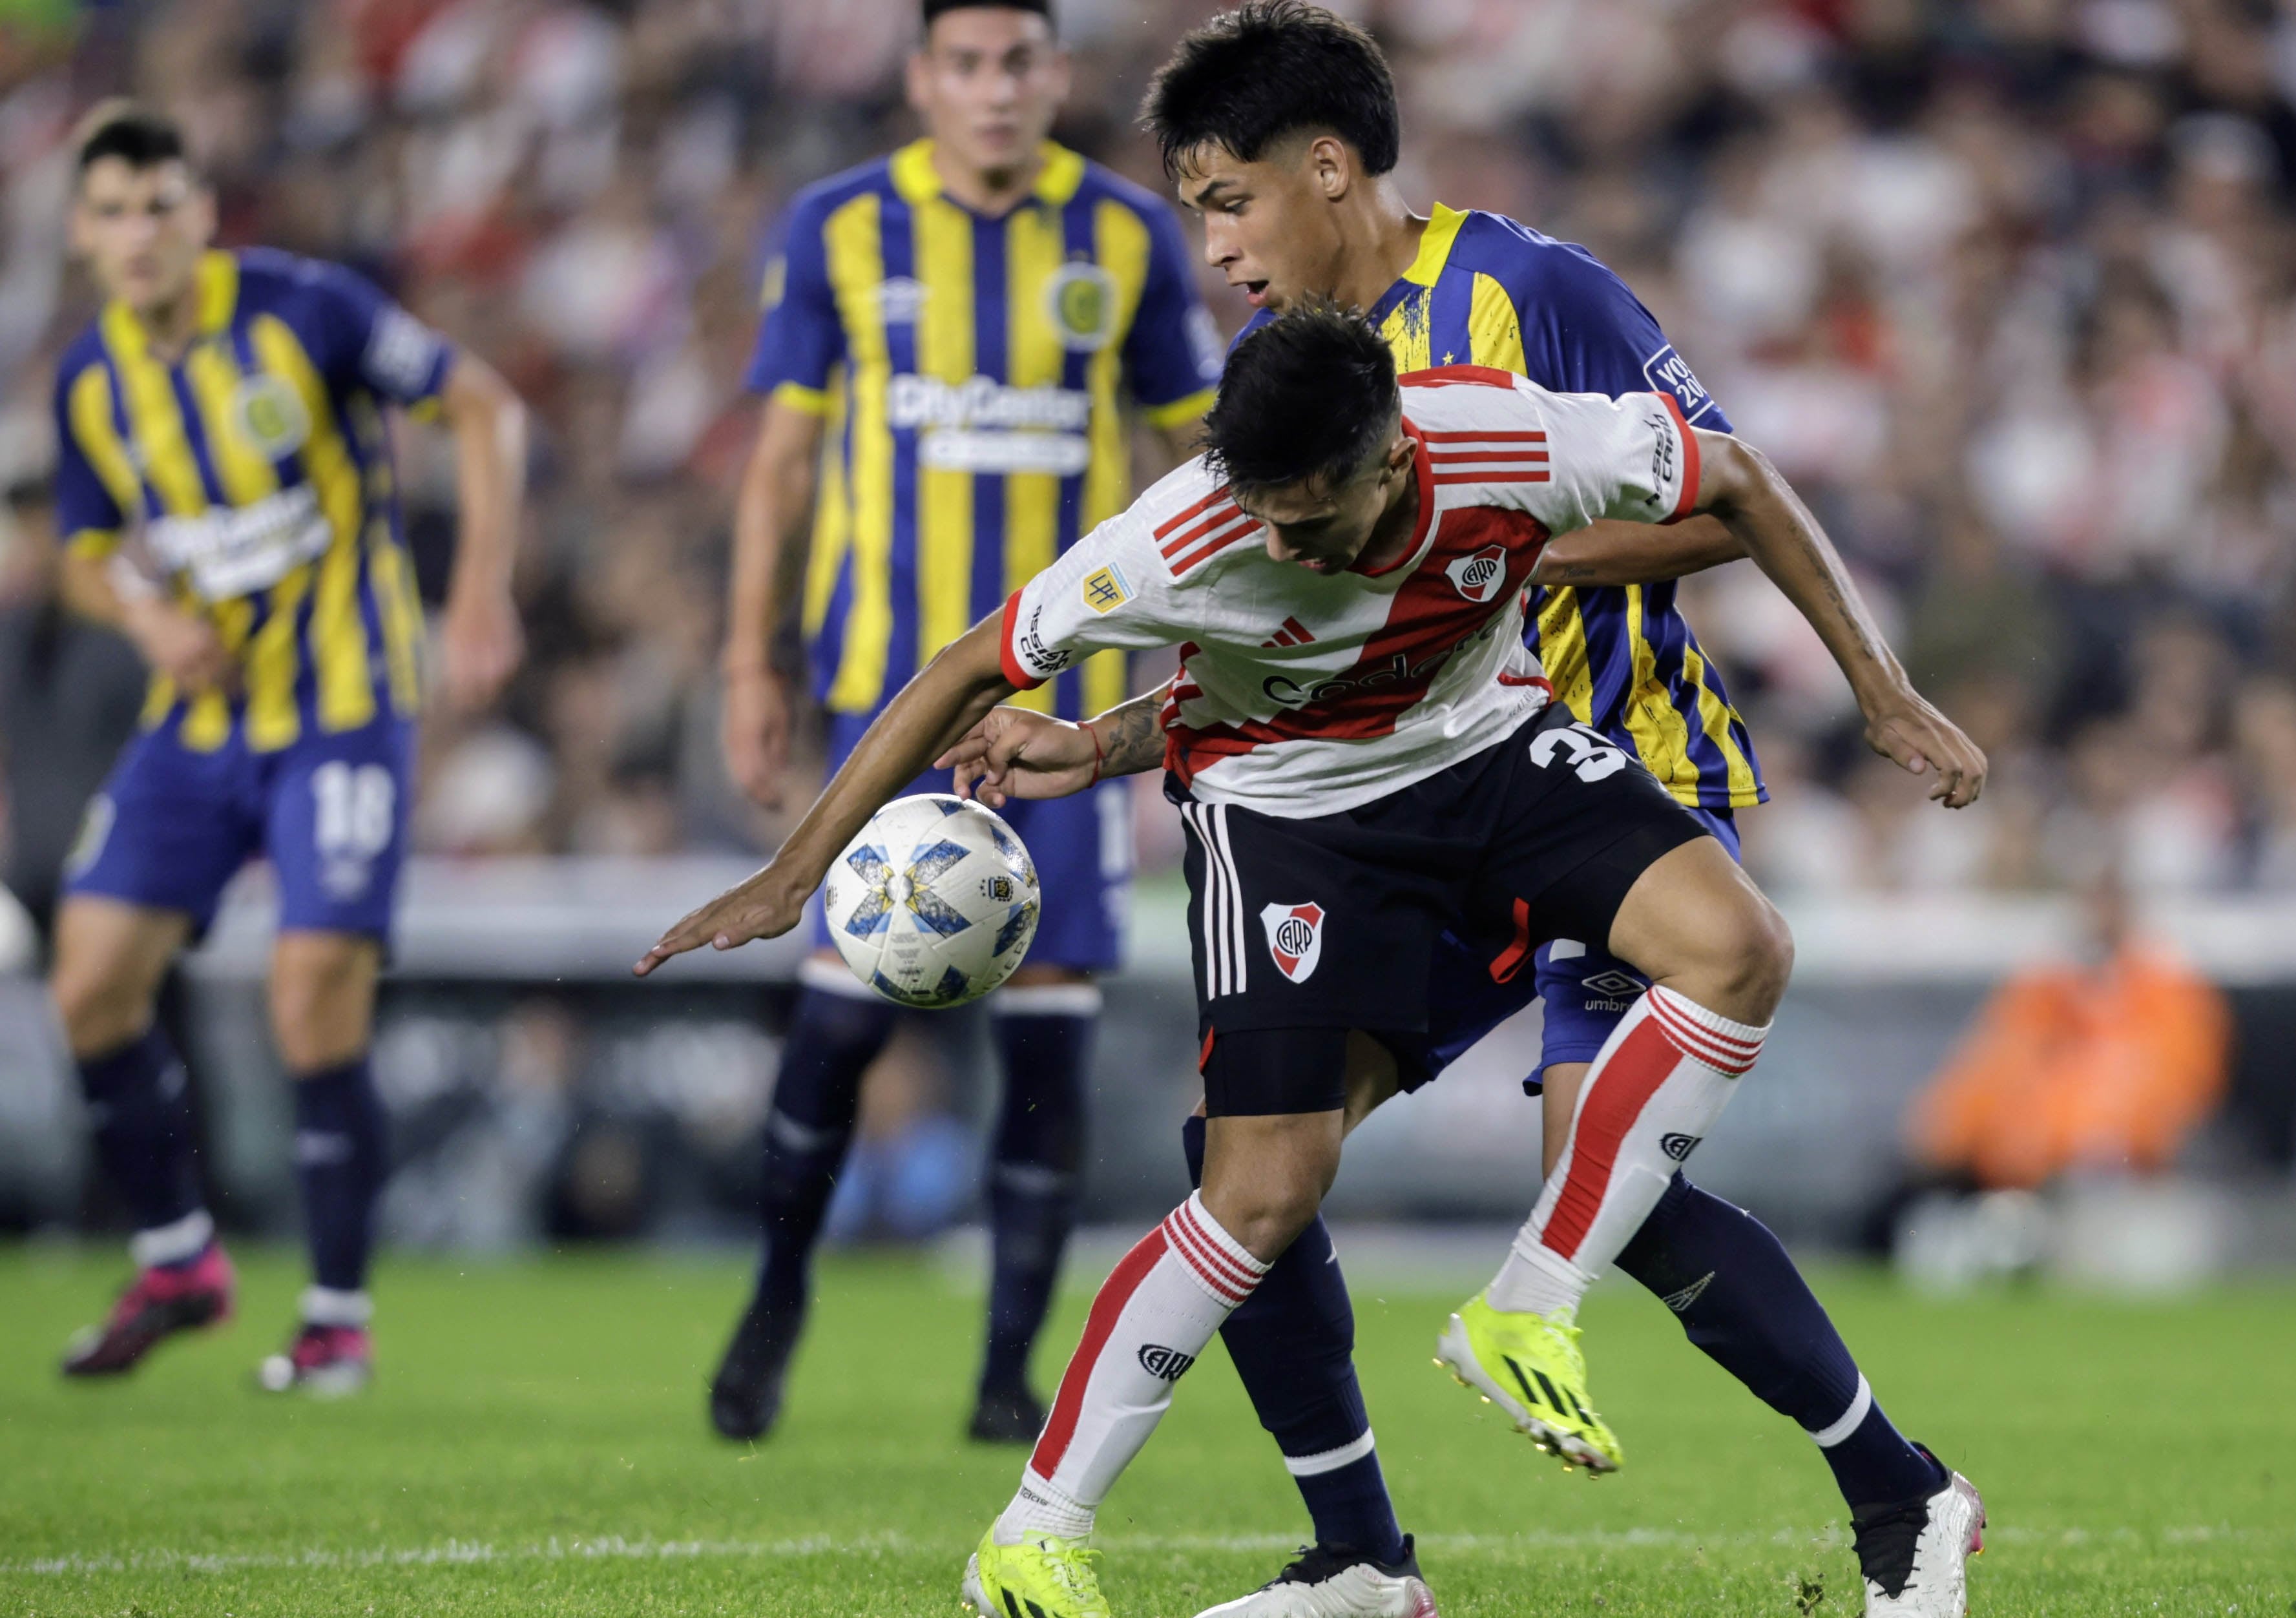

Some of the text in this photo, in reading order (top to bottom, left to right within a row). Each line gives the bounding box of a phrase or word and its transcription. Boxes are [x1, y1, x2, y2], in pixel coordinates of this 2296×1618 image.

[1462, 559, 1498, 585] CARP
[1529, 721, 1638, 783] 3
[1277, 919, 1312, 955] CARP
